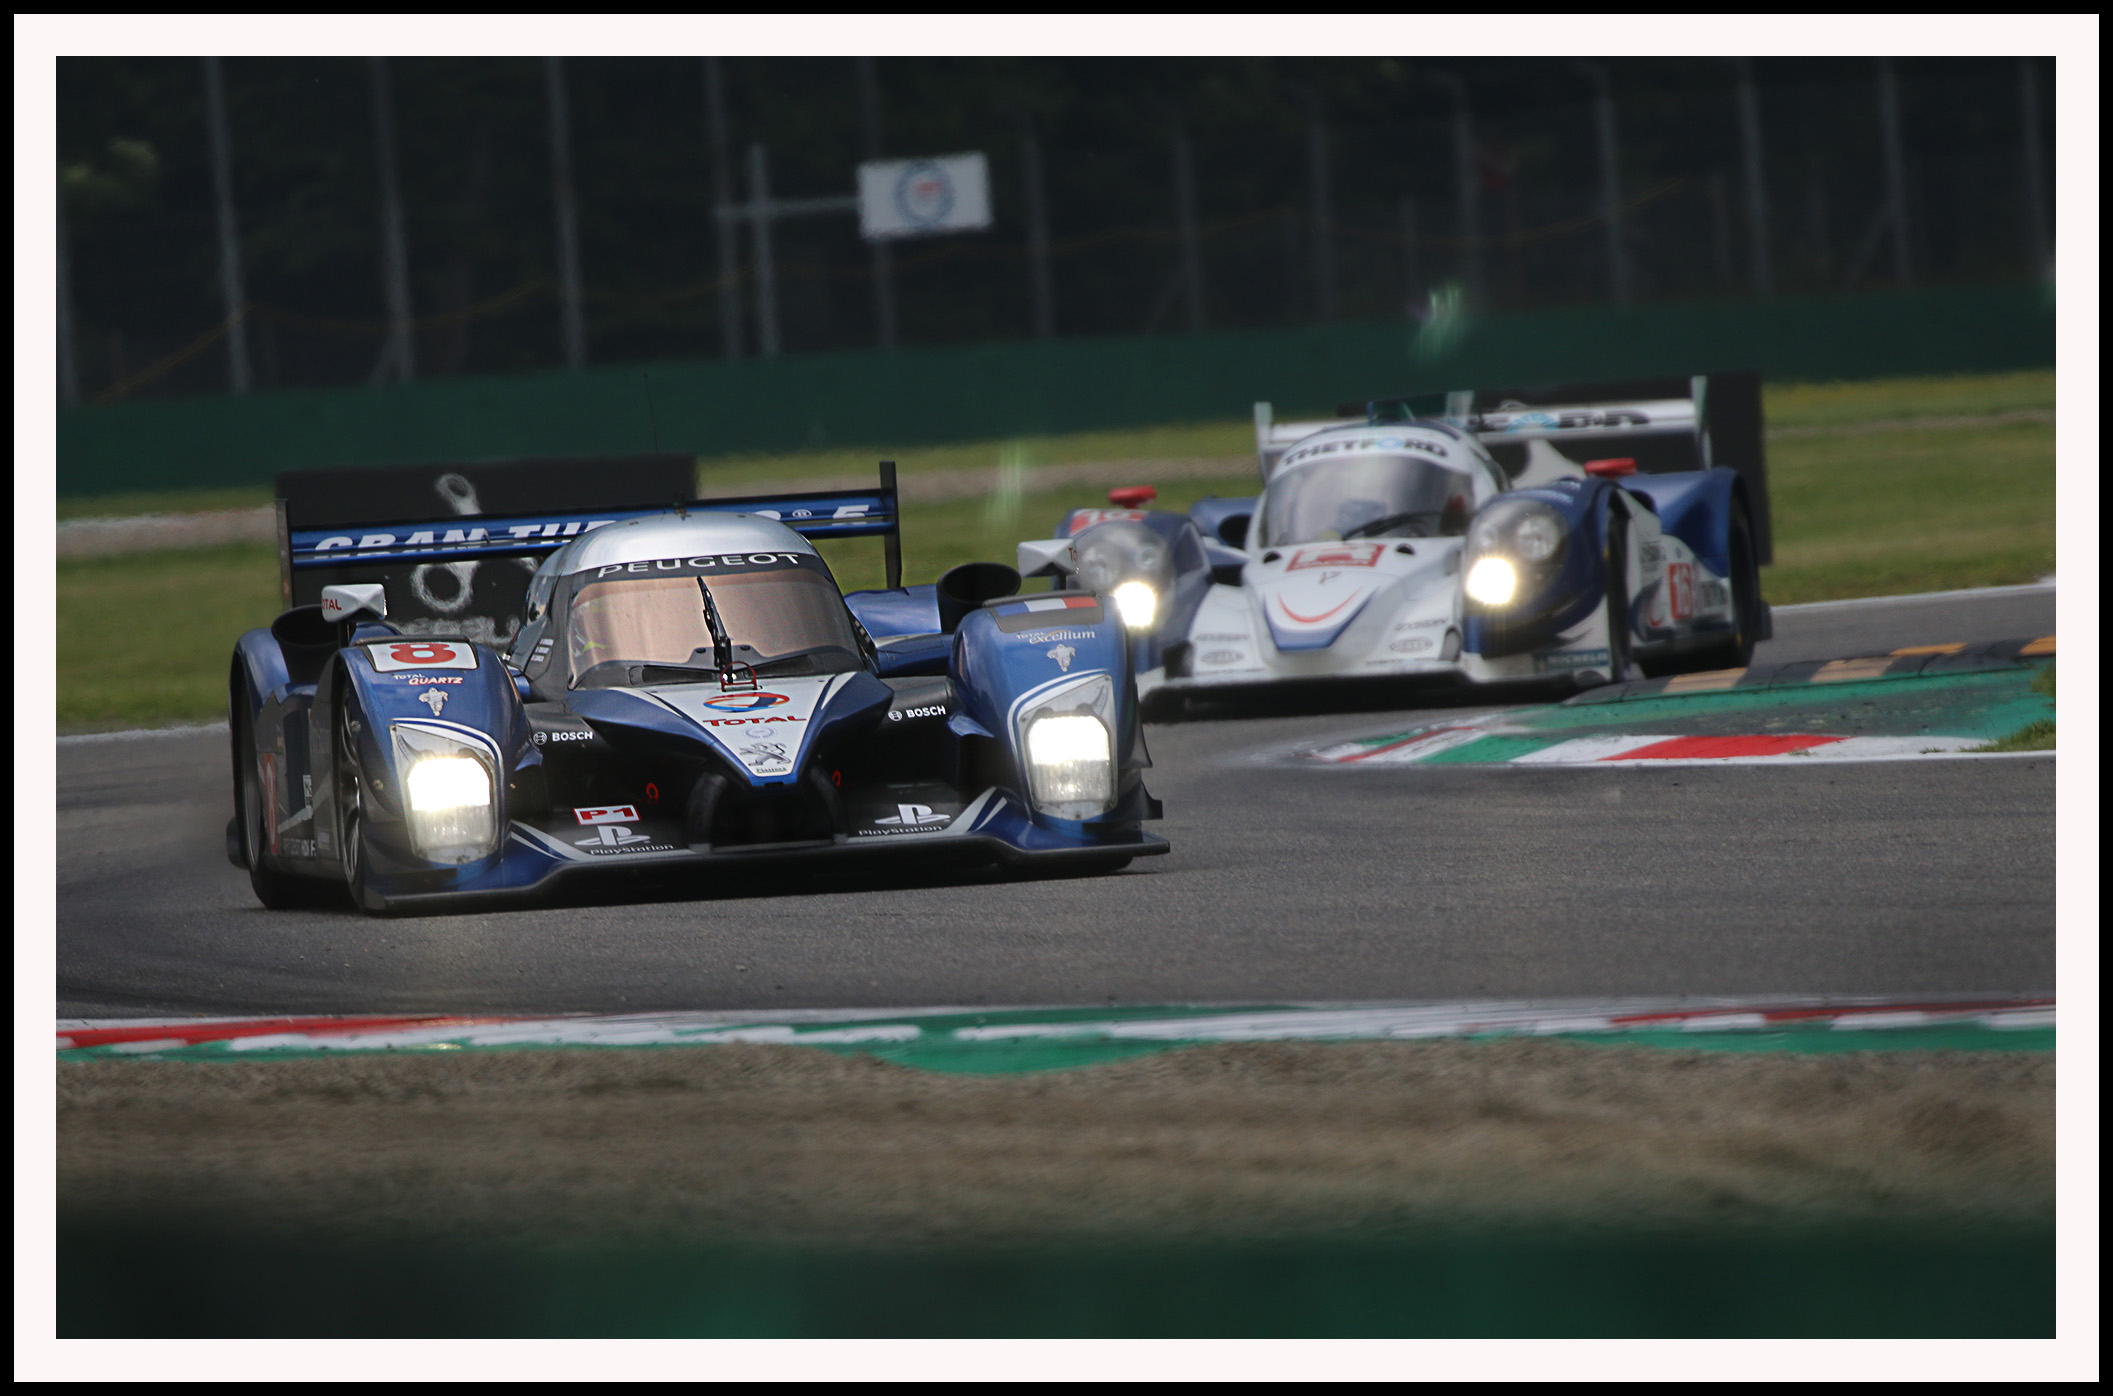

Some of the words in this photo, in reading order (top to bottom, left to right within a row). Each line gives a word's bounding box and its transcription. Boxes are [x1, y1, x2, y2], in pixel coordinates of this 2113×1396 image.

[597, 553, 801, 579] PEUGEOT
[1029, 629, 1096, 645] excellium
[389, 642, 457, 665] 8
[408, 676, 464, 686] QUARTZ
[905, 705, 947, 719] BOSCH
[702, 715, 807, 727] TOTAL
[551, 731, 594, 742] BOSCH
[579, 807, 635, 821] P1
[858, 824, 943, 837] PlayStation
[590, 844, 674, 856] PlayStation
